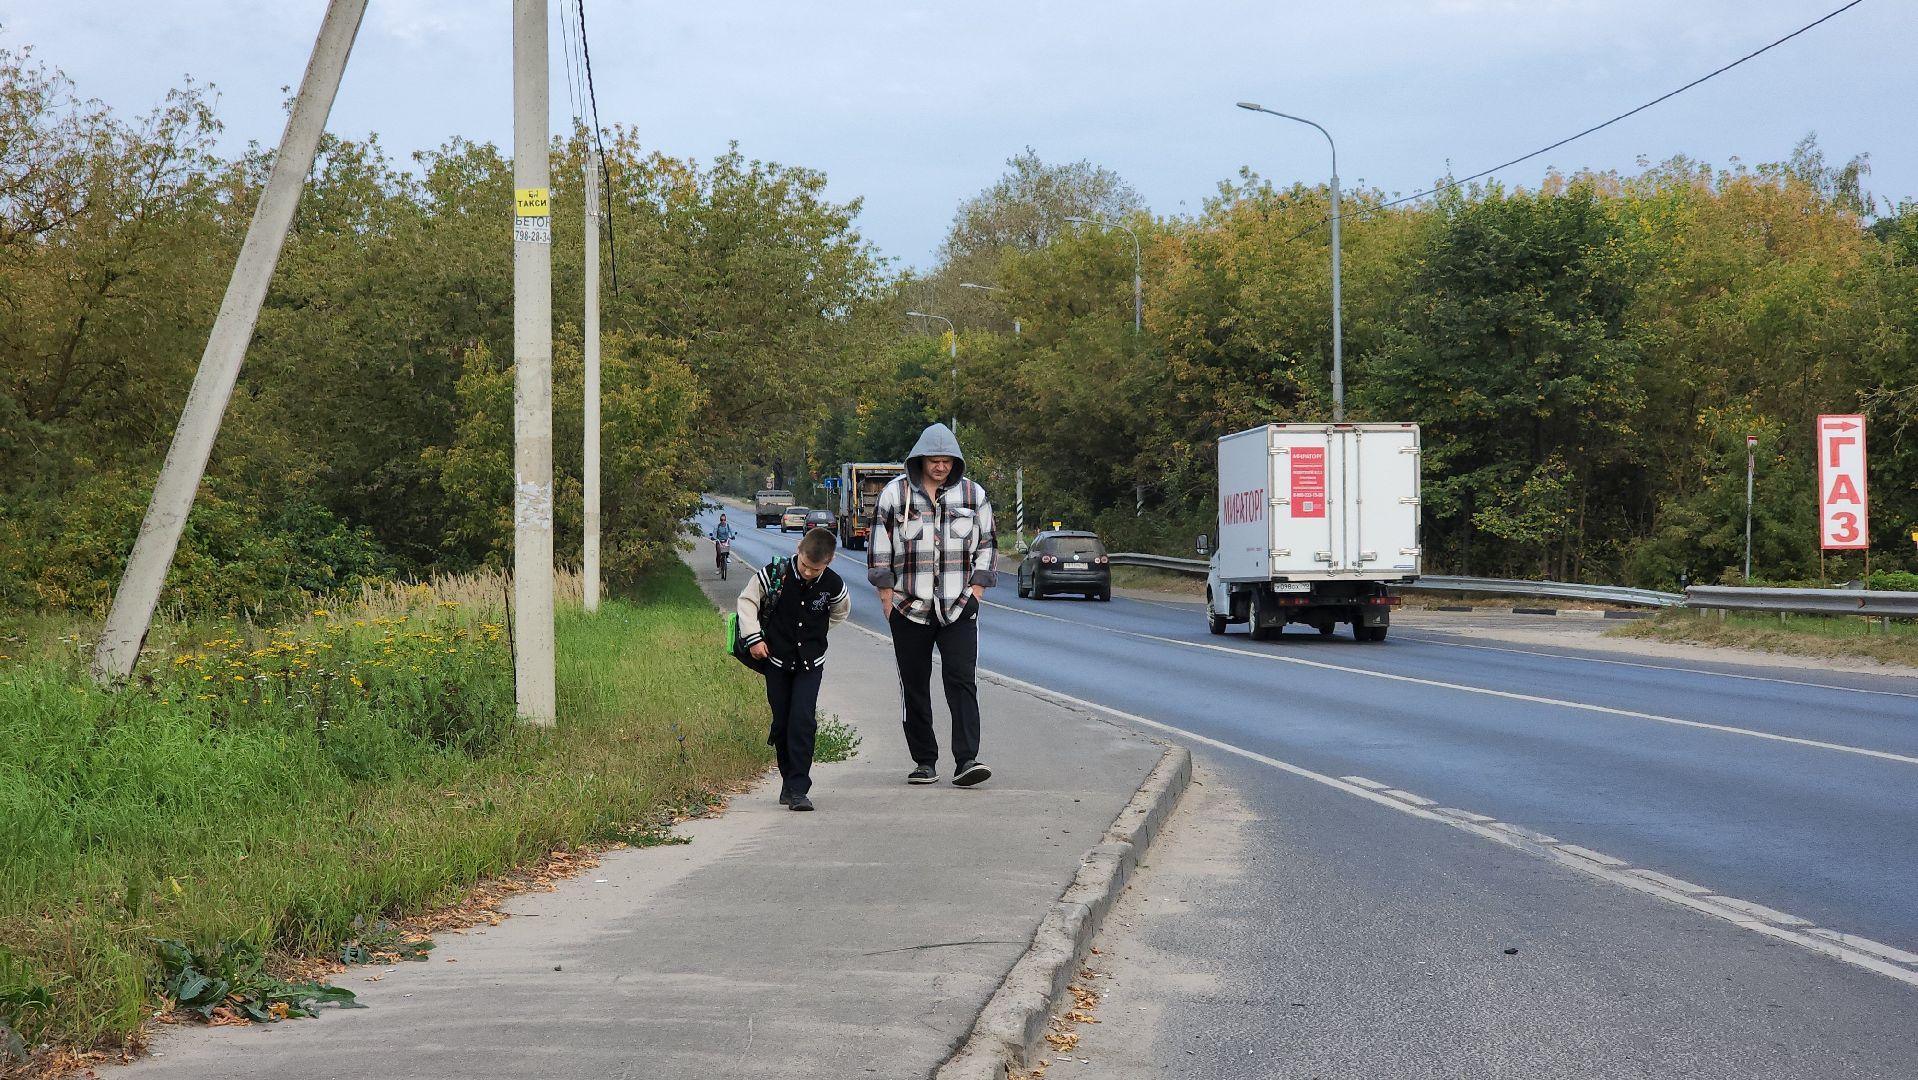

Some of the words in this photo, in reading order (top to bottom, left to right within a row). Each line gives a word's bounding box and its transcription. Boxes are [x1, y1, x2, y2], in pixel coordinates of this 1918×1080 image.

[517, 199, 547, 207] ТАКСИ
[1223, 488, 1264, 526] МИРАТОРГ
[1826, 436, 1862, 543] ГАЗ
